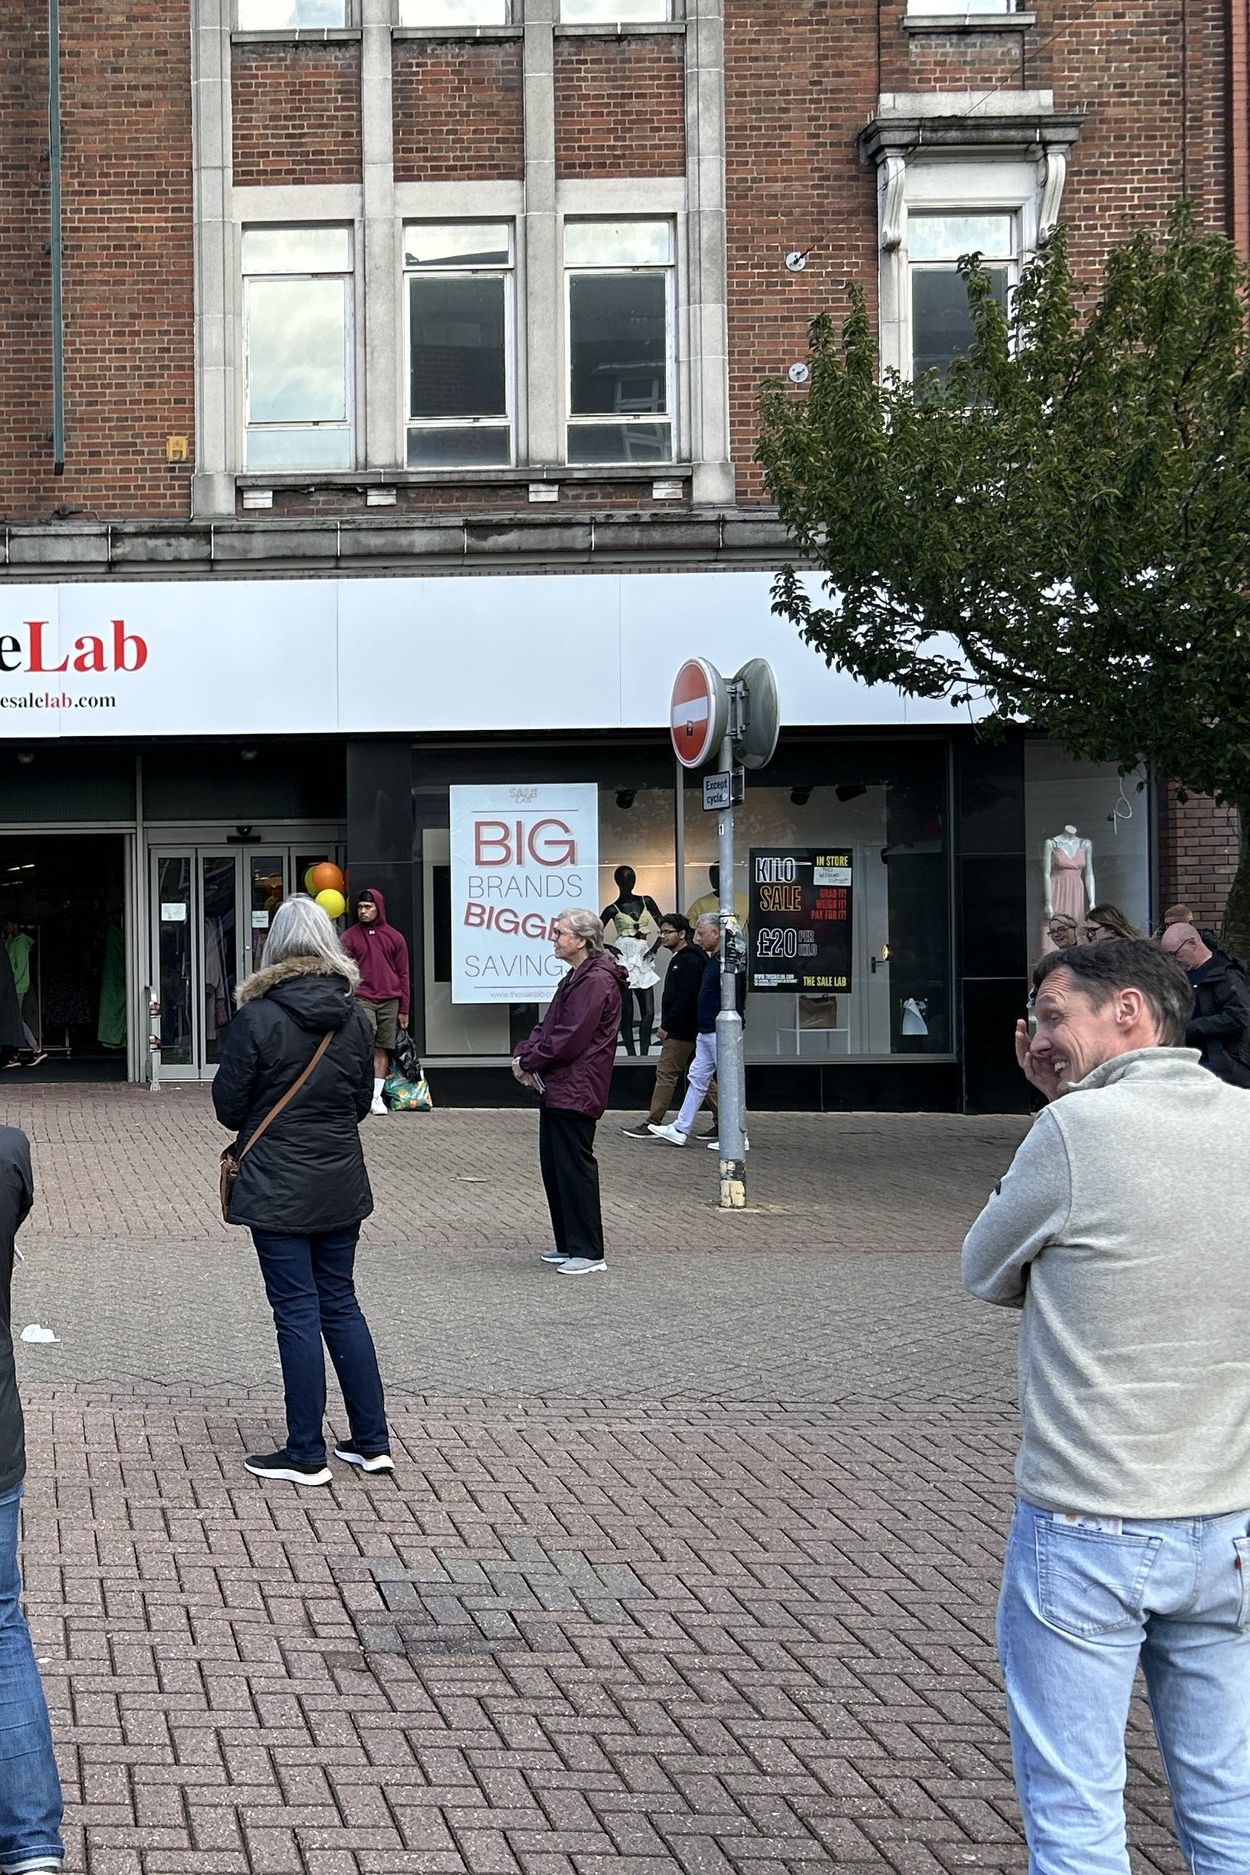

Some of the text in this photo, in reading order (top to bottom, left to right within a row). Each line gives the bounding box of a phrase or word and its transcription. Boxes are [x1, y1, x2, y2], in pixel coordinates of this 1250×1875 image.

[706, 779, 728, 791] Except
[707, 793, 727, 805] cycle
[474, 818, 578, 868] BIG
[755, 857, 796, 883] KILO
[816, 855, 849, 867] IN STORE
[468, 875, 583, 899] BRANDS
[759, 885, 802, 912] SALE
[463, 901, 561, 942] BIGGE
[756, 928, 797, 958] £20
[464, 954, 569, 977] SAVING
[803, 976, 816, 986] THE
[816, 976, 833, 986] SALE
[833, 976, 847, 986] LAB
